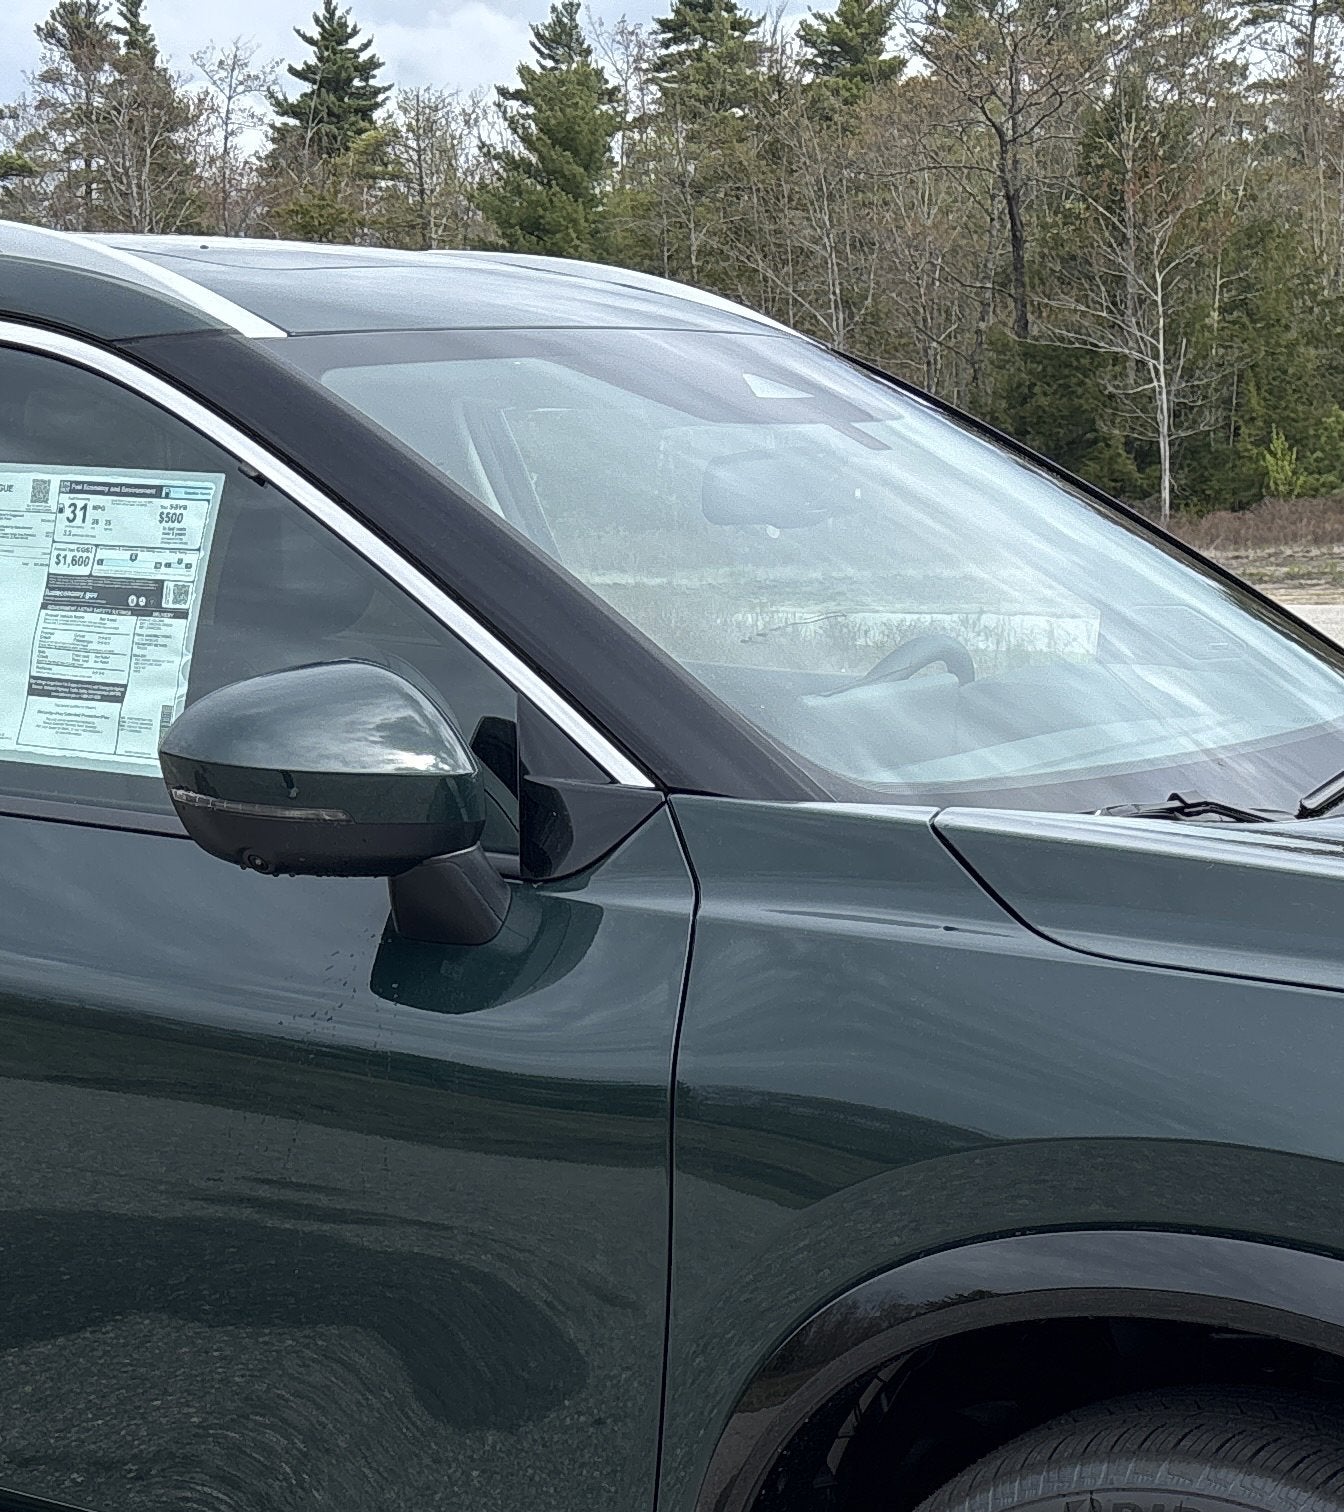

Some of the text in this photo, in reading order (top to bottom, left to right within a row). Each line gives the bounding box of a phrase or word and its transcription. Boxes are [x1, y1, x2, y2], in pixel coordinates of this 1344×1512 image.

[66, 502, 88, 524] 31
[158, 511, 184, 525] $500
[55, 553, 90, 568] $1,600
